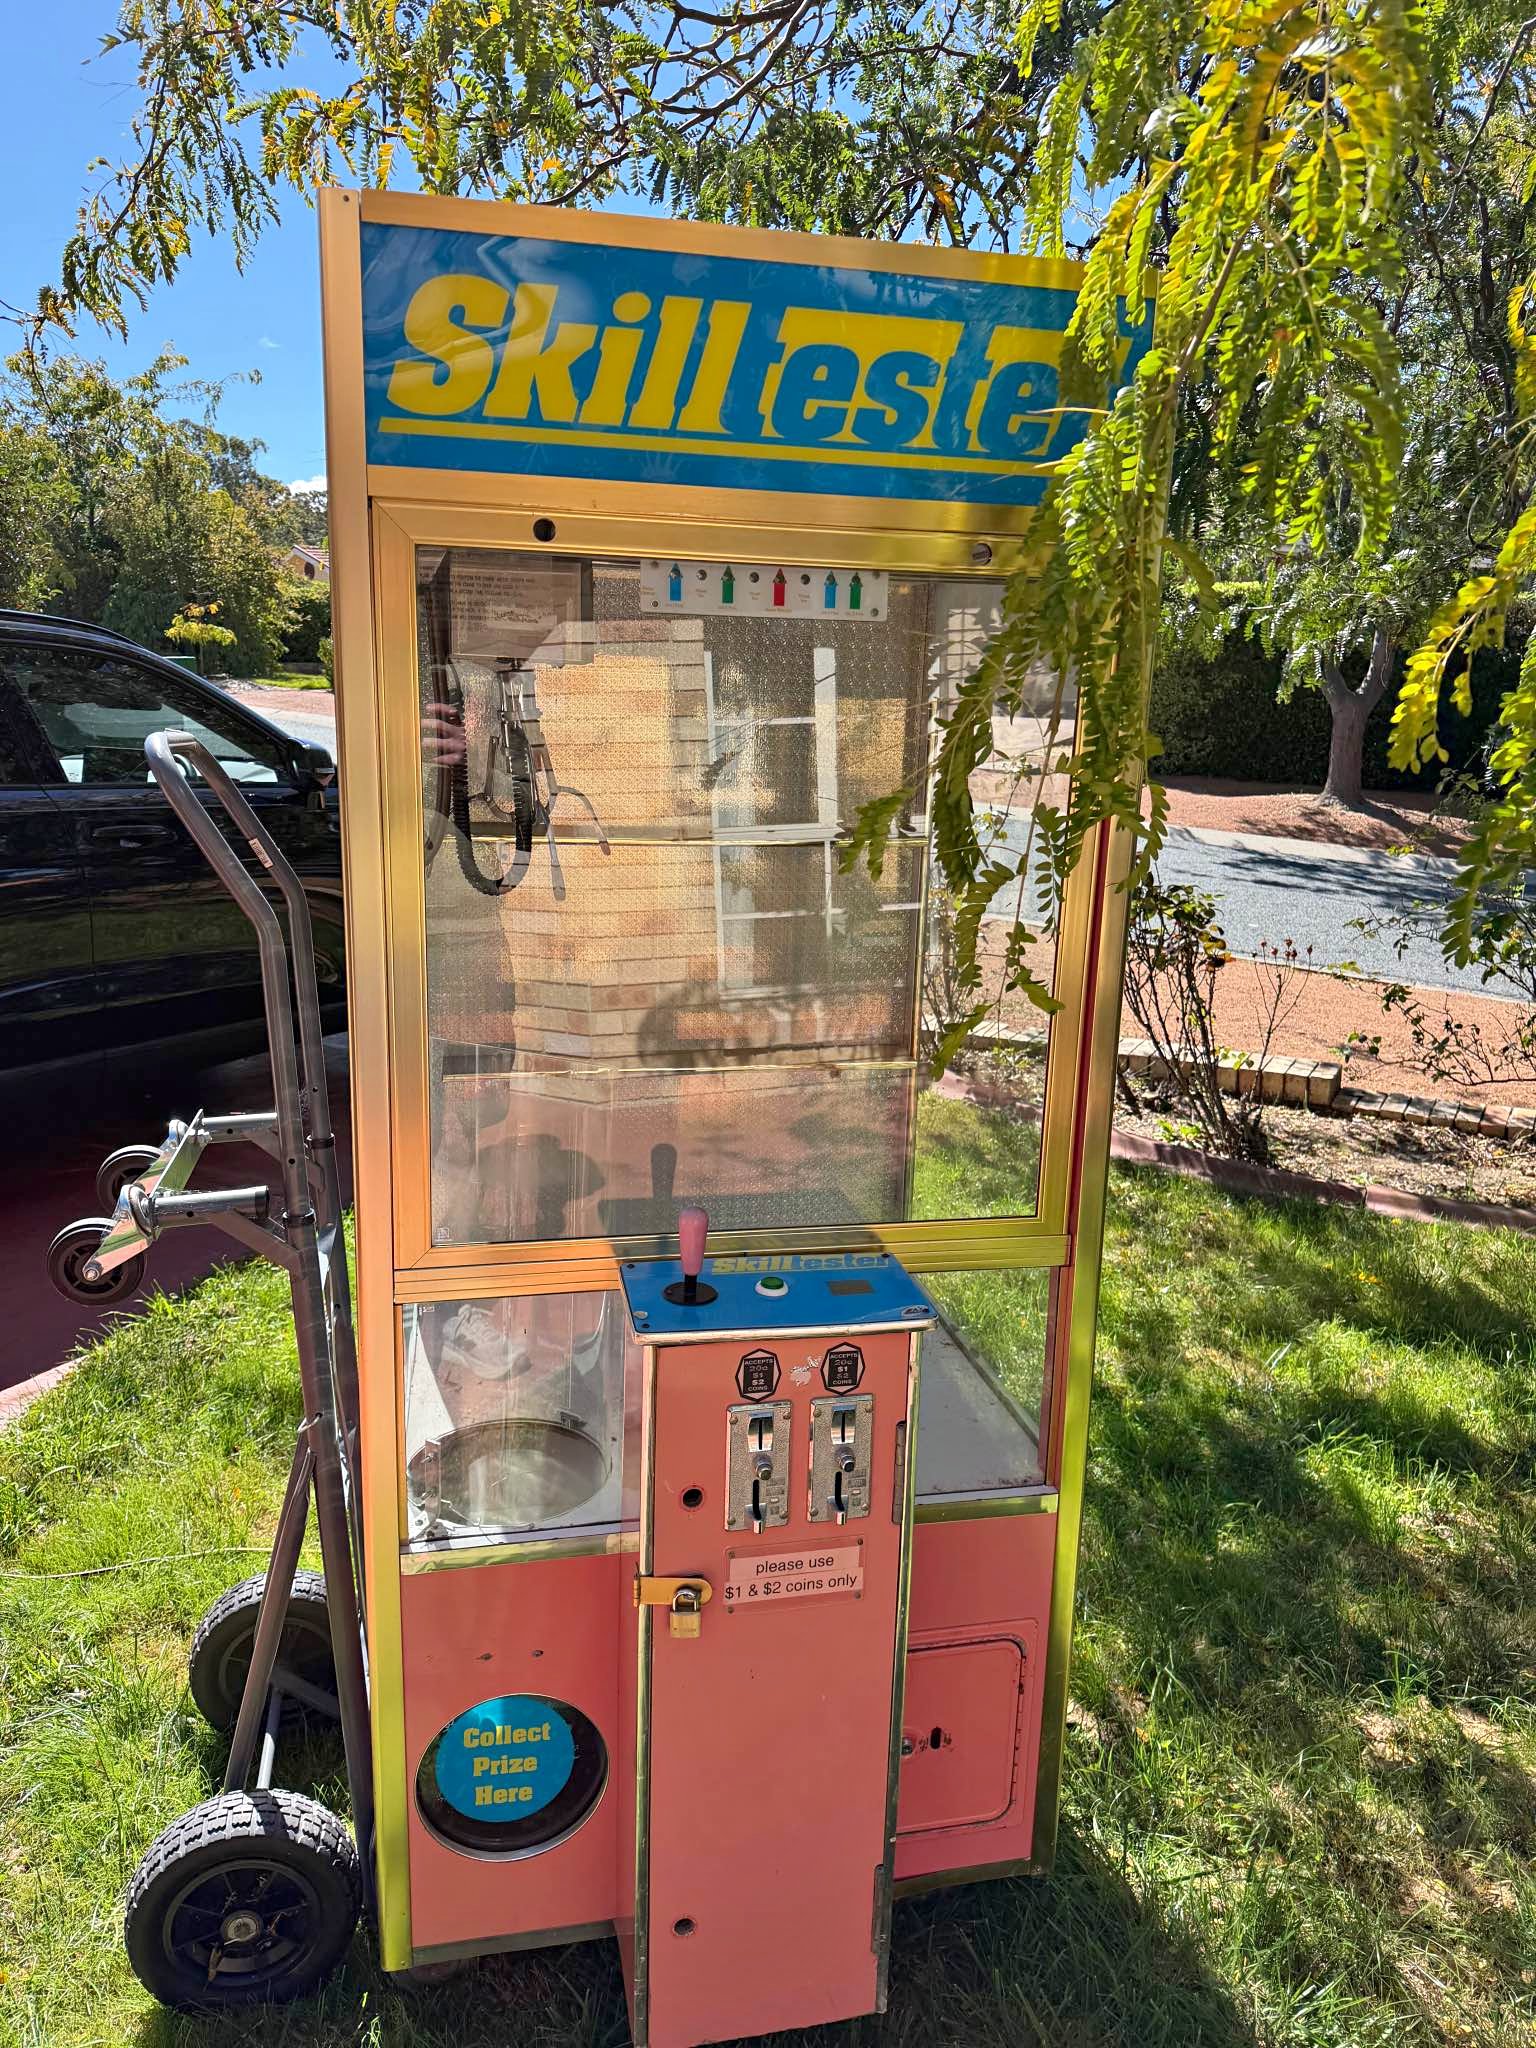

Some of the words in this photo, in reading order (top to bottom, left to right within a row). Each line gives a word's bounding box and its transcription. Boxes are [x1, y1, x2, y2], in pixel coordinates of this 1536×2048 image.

[756, 1560, 804, 1576] please
[808, 1556, 834, 1569] use
[725, 1586, 741, 1600] $1
[748, 1584, 758, 1597] &
[763, 1581, 781, 1596] $2
[786, 1578, 823, 1593] coins
[828, 1573, 858, 1588] only
[463, 1722, 551, 1749] Collect
[473, 1755, 538, 1777] Prize
[475, 1785, 533, 1806] Here
